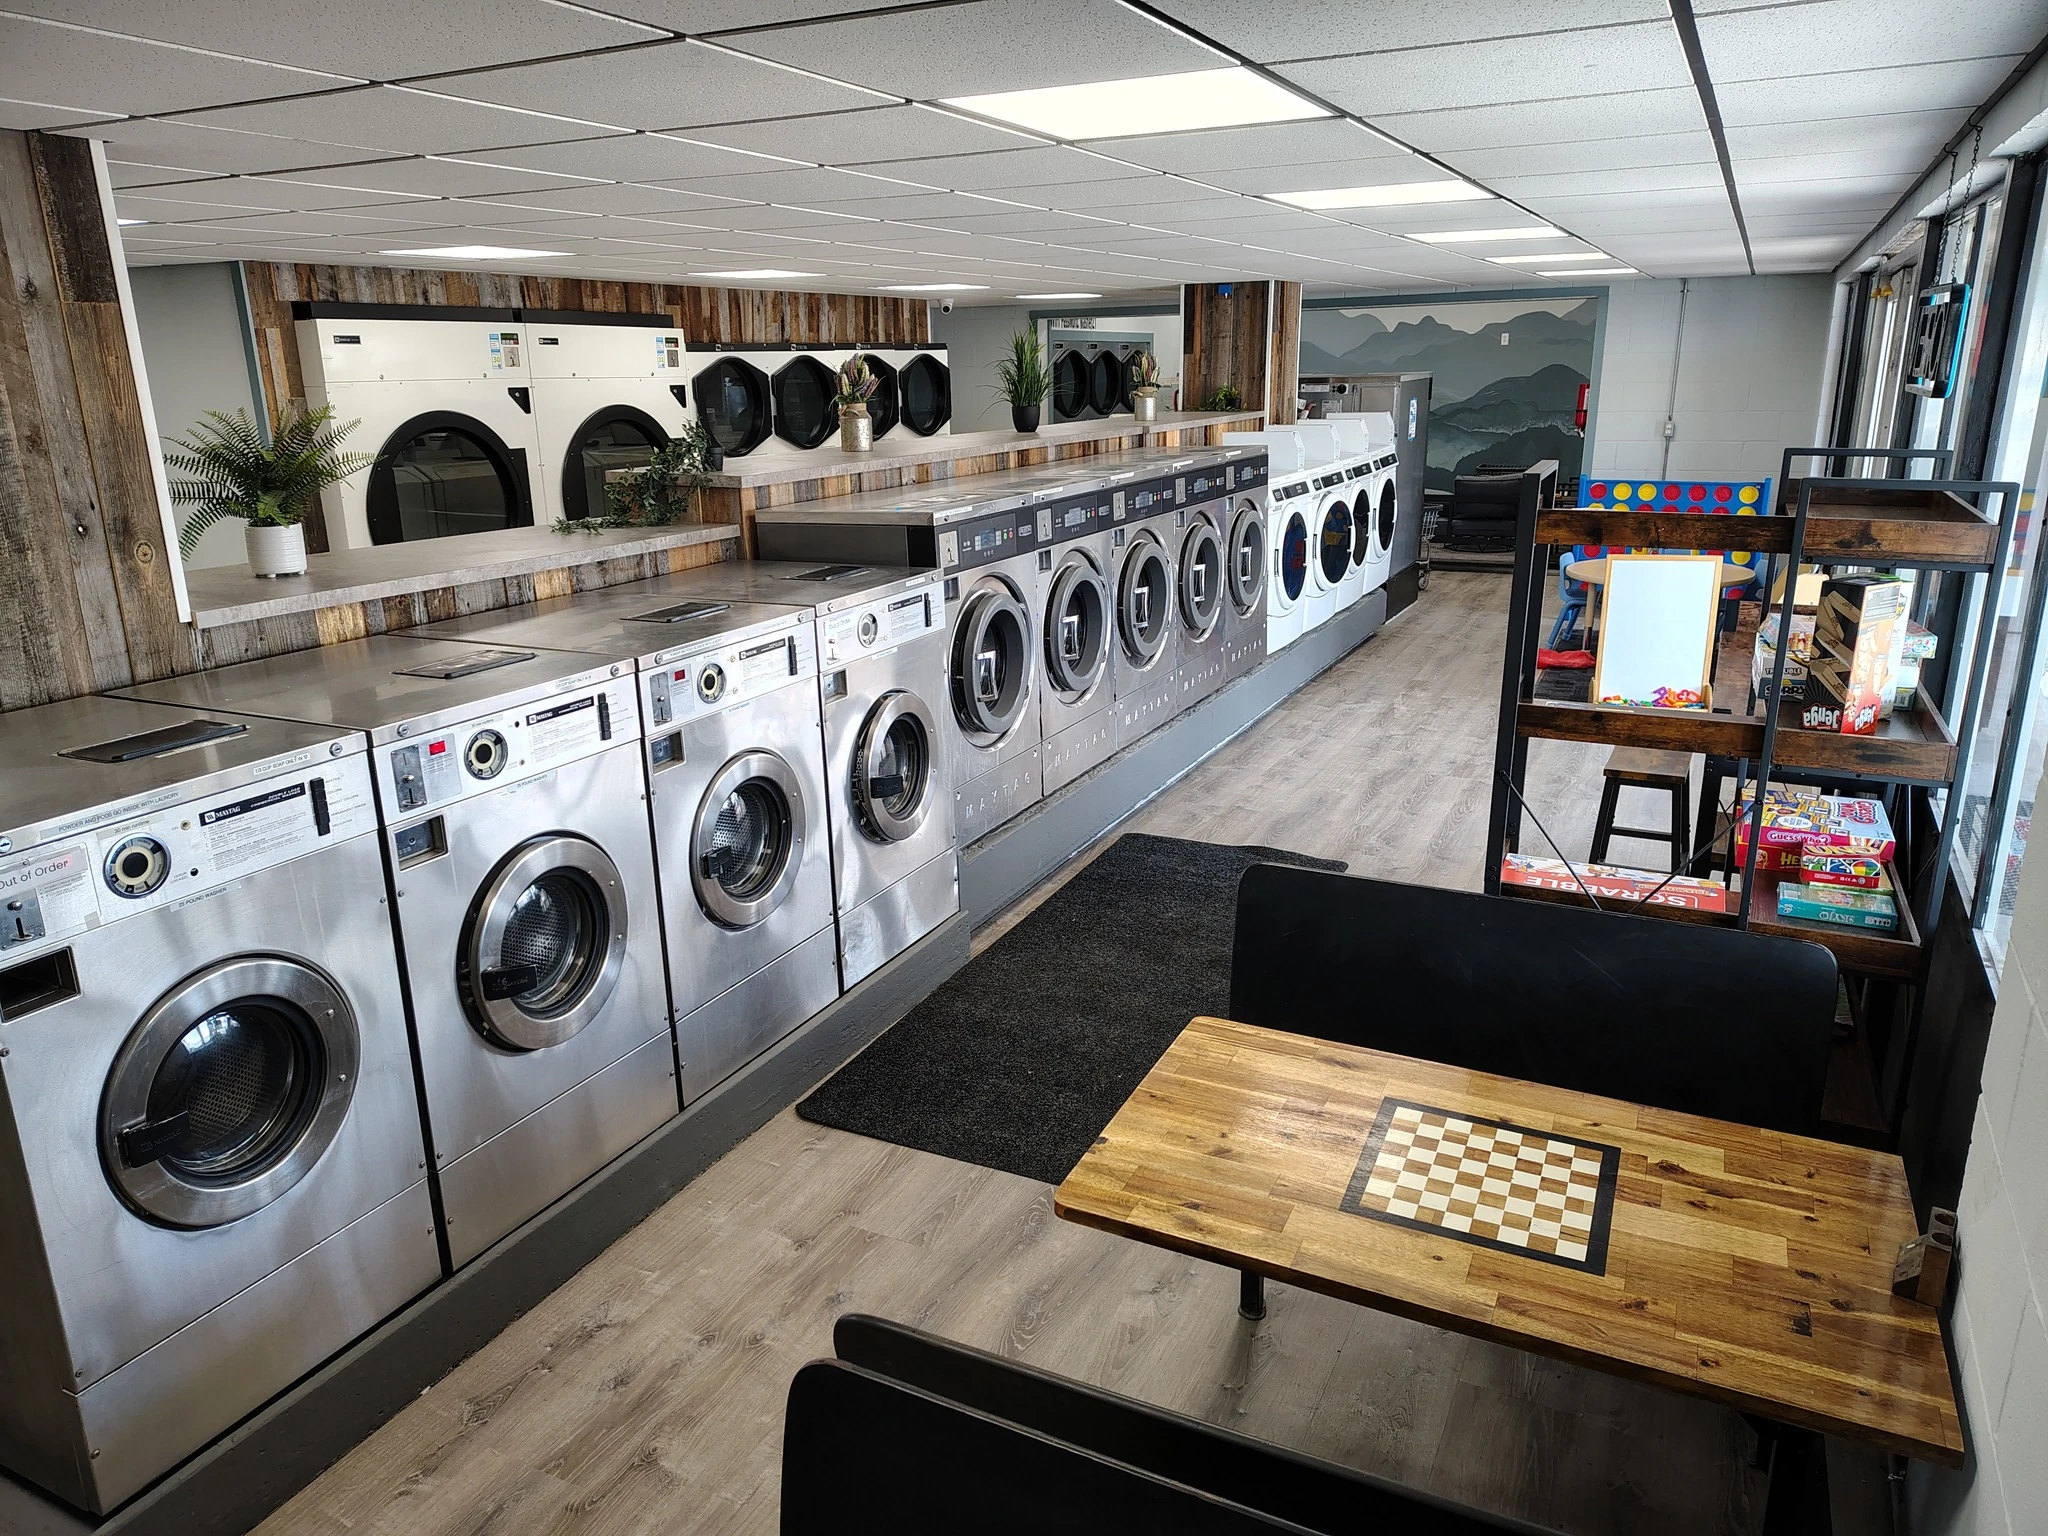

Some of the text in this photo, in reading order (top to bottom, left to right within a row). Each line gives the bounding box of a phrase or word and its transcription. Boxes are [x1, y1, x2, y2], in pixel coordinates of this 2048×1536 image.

[1803, 706, 1840, 729] Jenga
[1854, 705, 1877, 732] Jenga
[272, 761, 285, 769] SOAP
[286, 755, 297, 764] ONLY
[58, 820, 84, 833] POWDER
[84, 817, 96, 825] AND
[97, 811, 112, 822] PODS
[122, 803, 141, 814] INSIDE
[140, 799, 155, 808] WITH
[155, 791, 180, 804] LAUNDRY
[215, 805, 241, 819] MAYTAG
[131, 820, 150, 830] runtime
[1770, 832, 1829, 845] Guess Who?
[1802, 846, 1879, 855] UNO
[0, 860, 69, 890] Out of Order
[185, 896, 205, 905] POUND
[204, 887, 227, 898] WASHER
[1819, 911, 1856, 924] SKYJO
